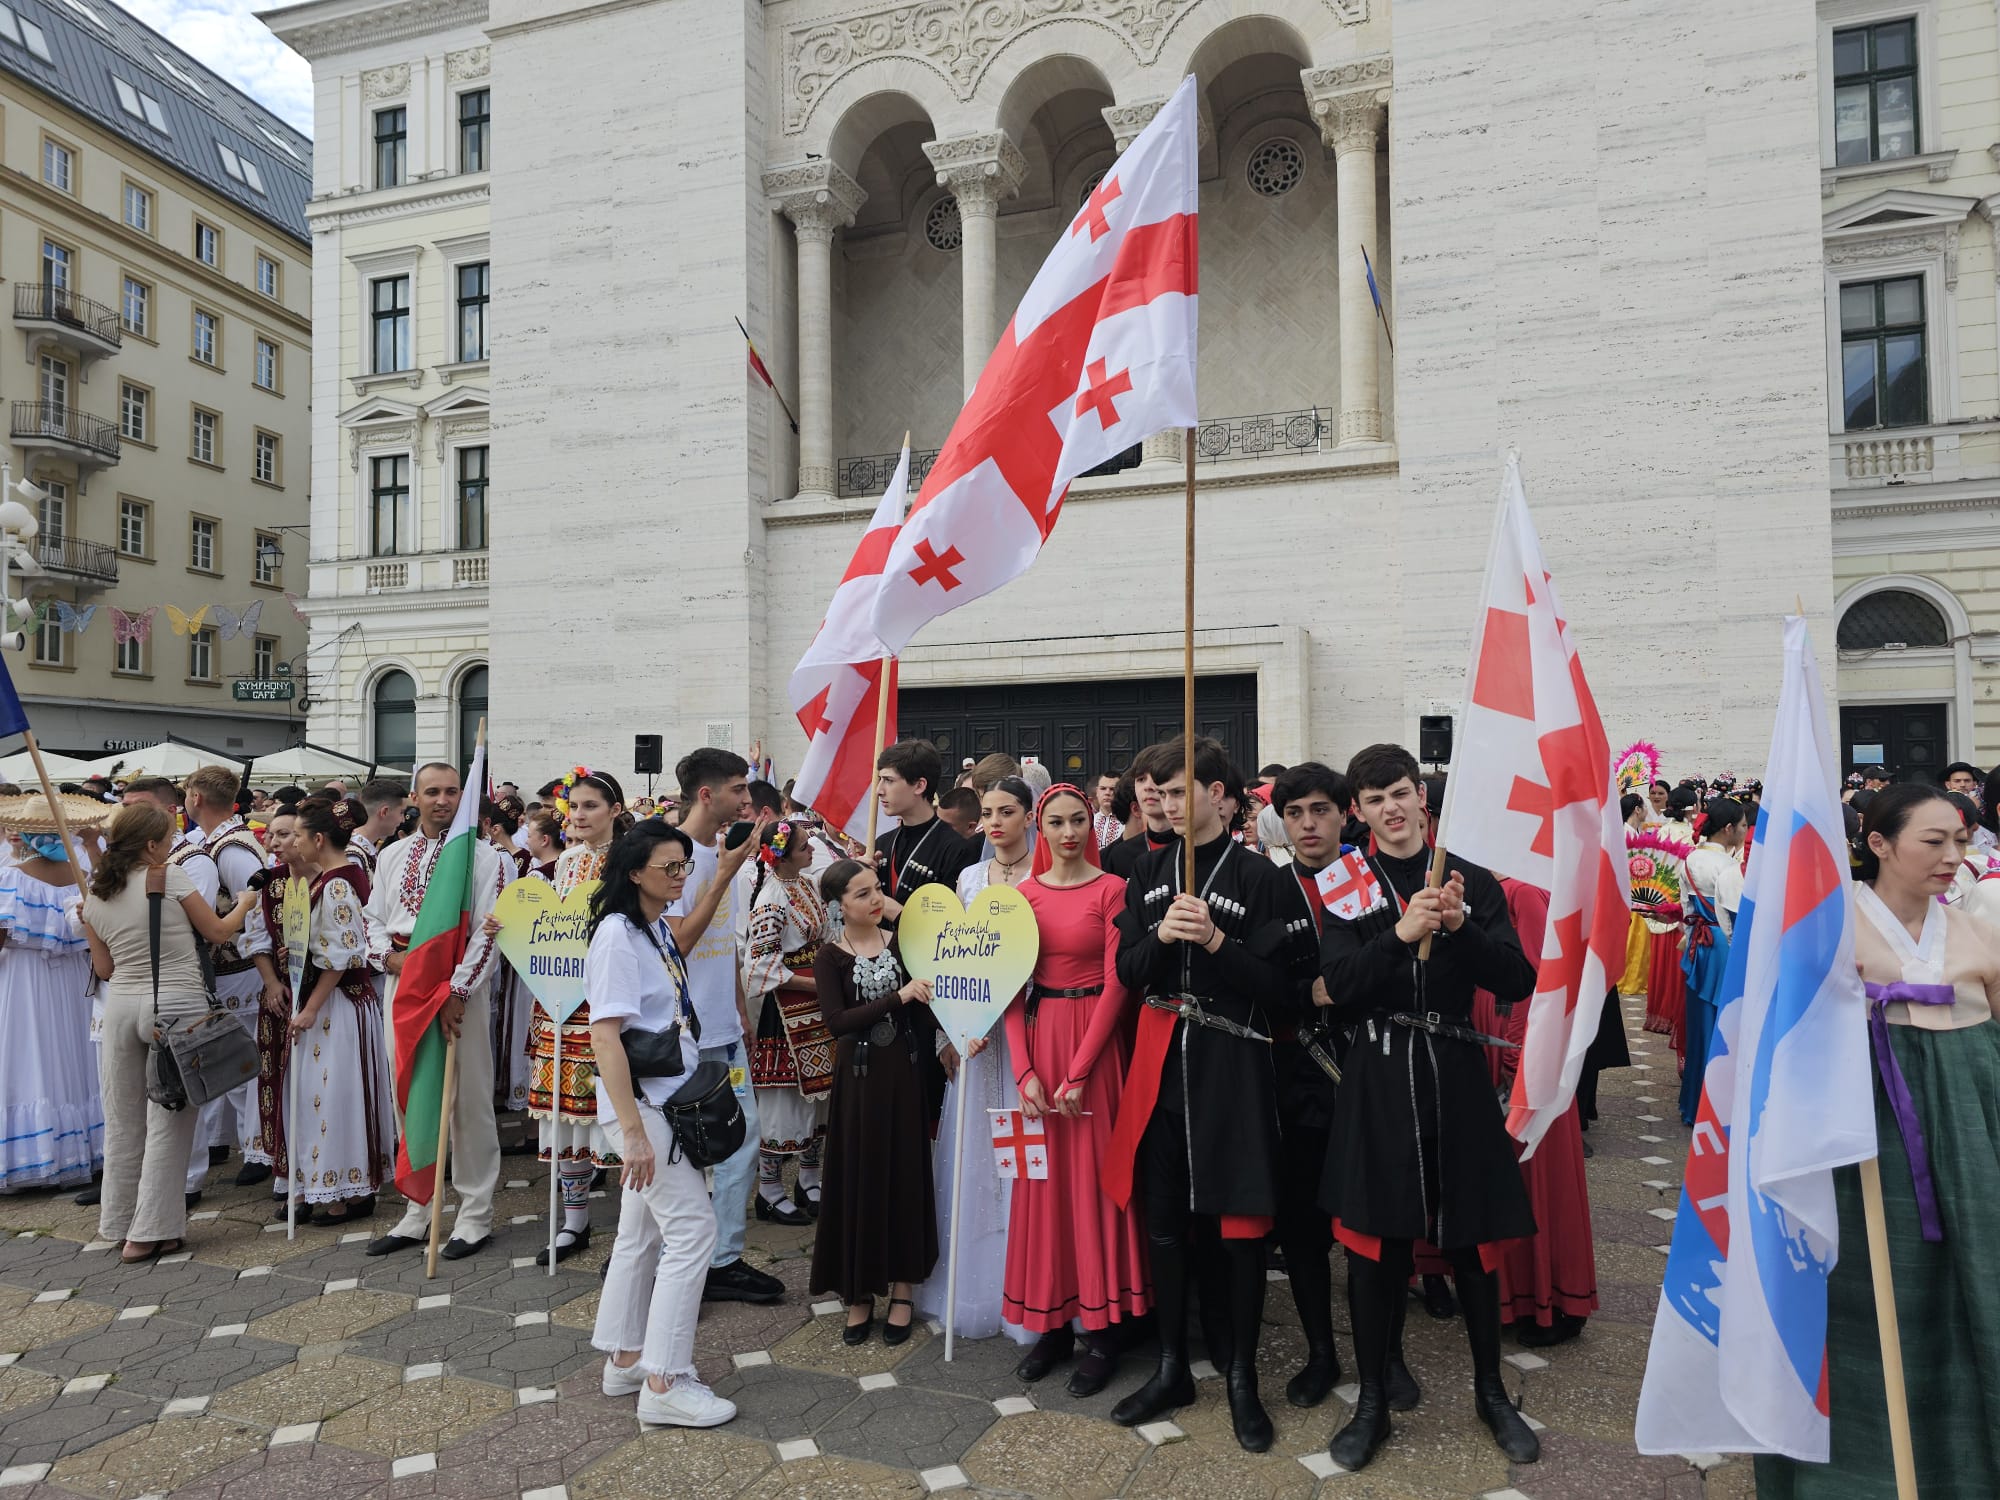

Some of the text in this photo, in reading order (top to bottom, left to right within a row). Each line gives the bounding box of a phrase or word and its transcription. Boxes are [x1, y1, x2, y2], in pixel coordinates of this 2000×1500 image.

[239, 681, 289, 690] SYMPHONY
[539, 909, 586, 925] Festivalul
[529, 918, 588, 944] Inimilo
[943, 920, 989, 938] Festivalul
[932, 932, 1001, 961] Inimilor
[529, 955, 585, 978] BULGARI
[935, 974, 991, 1003] GEORGIA
